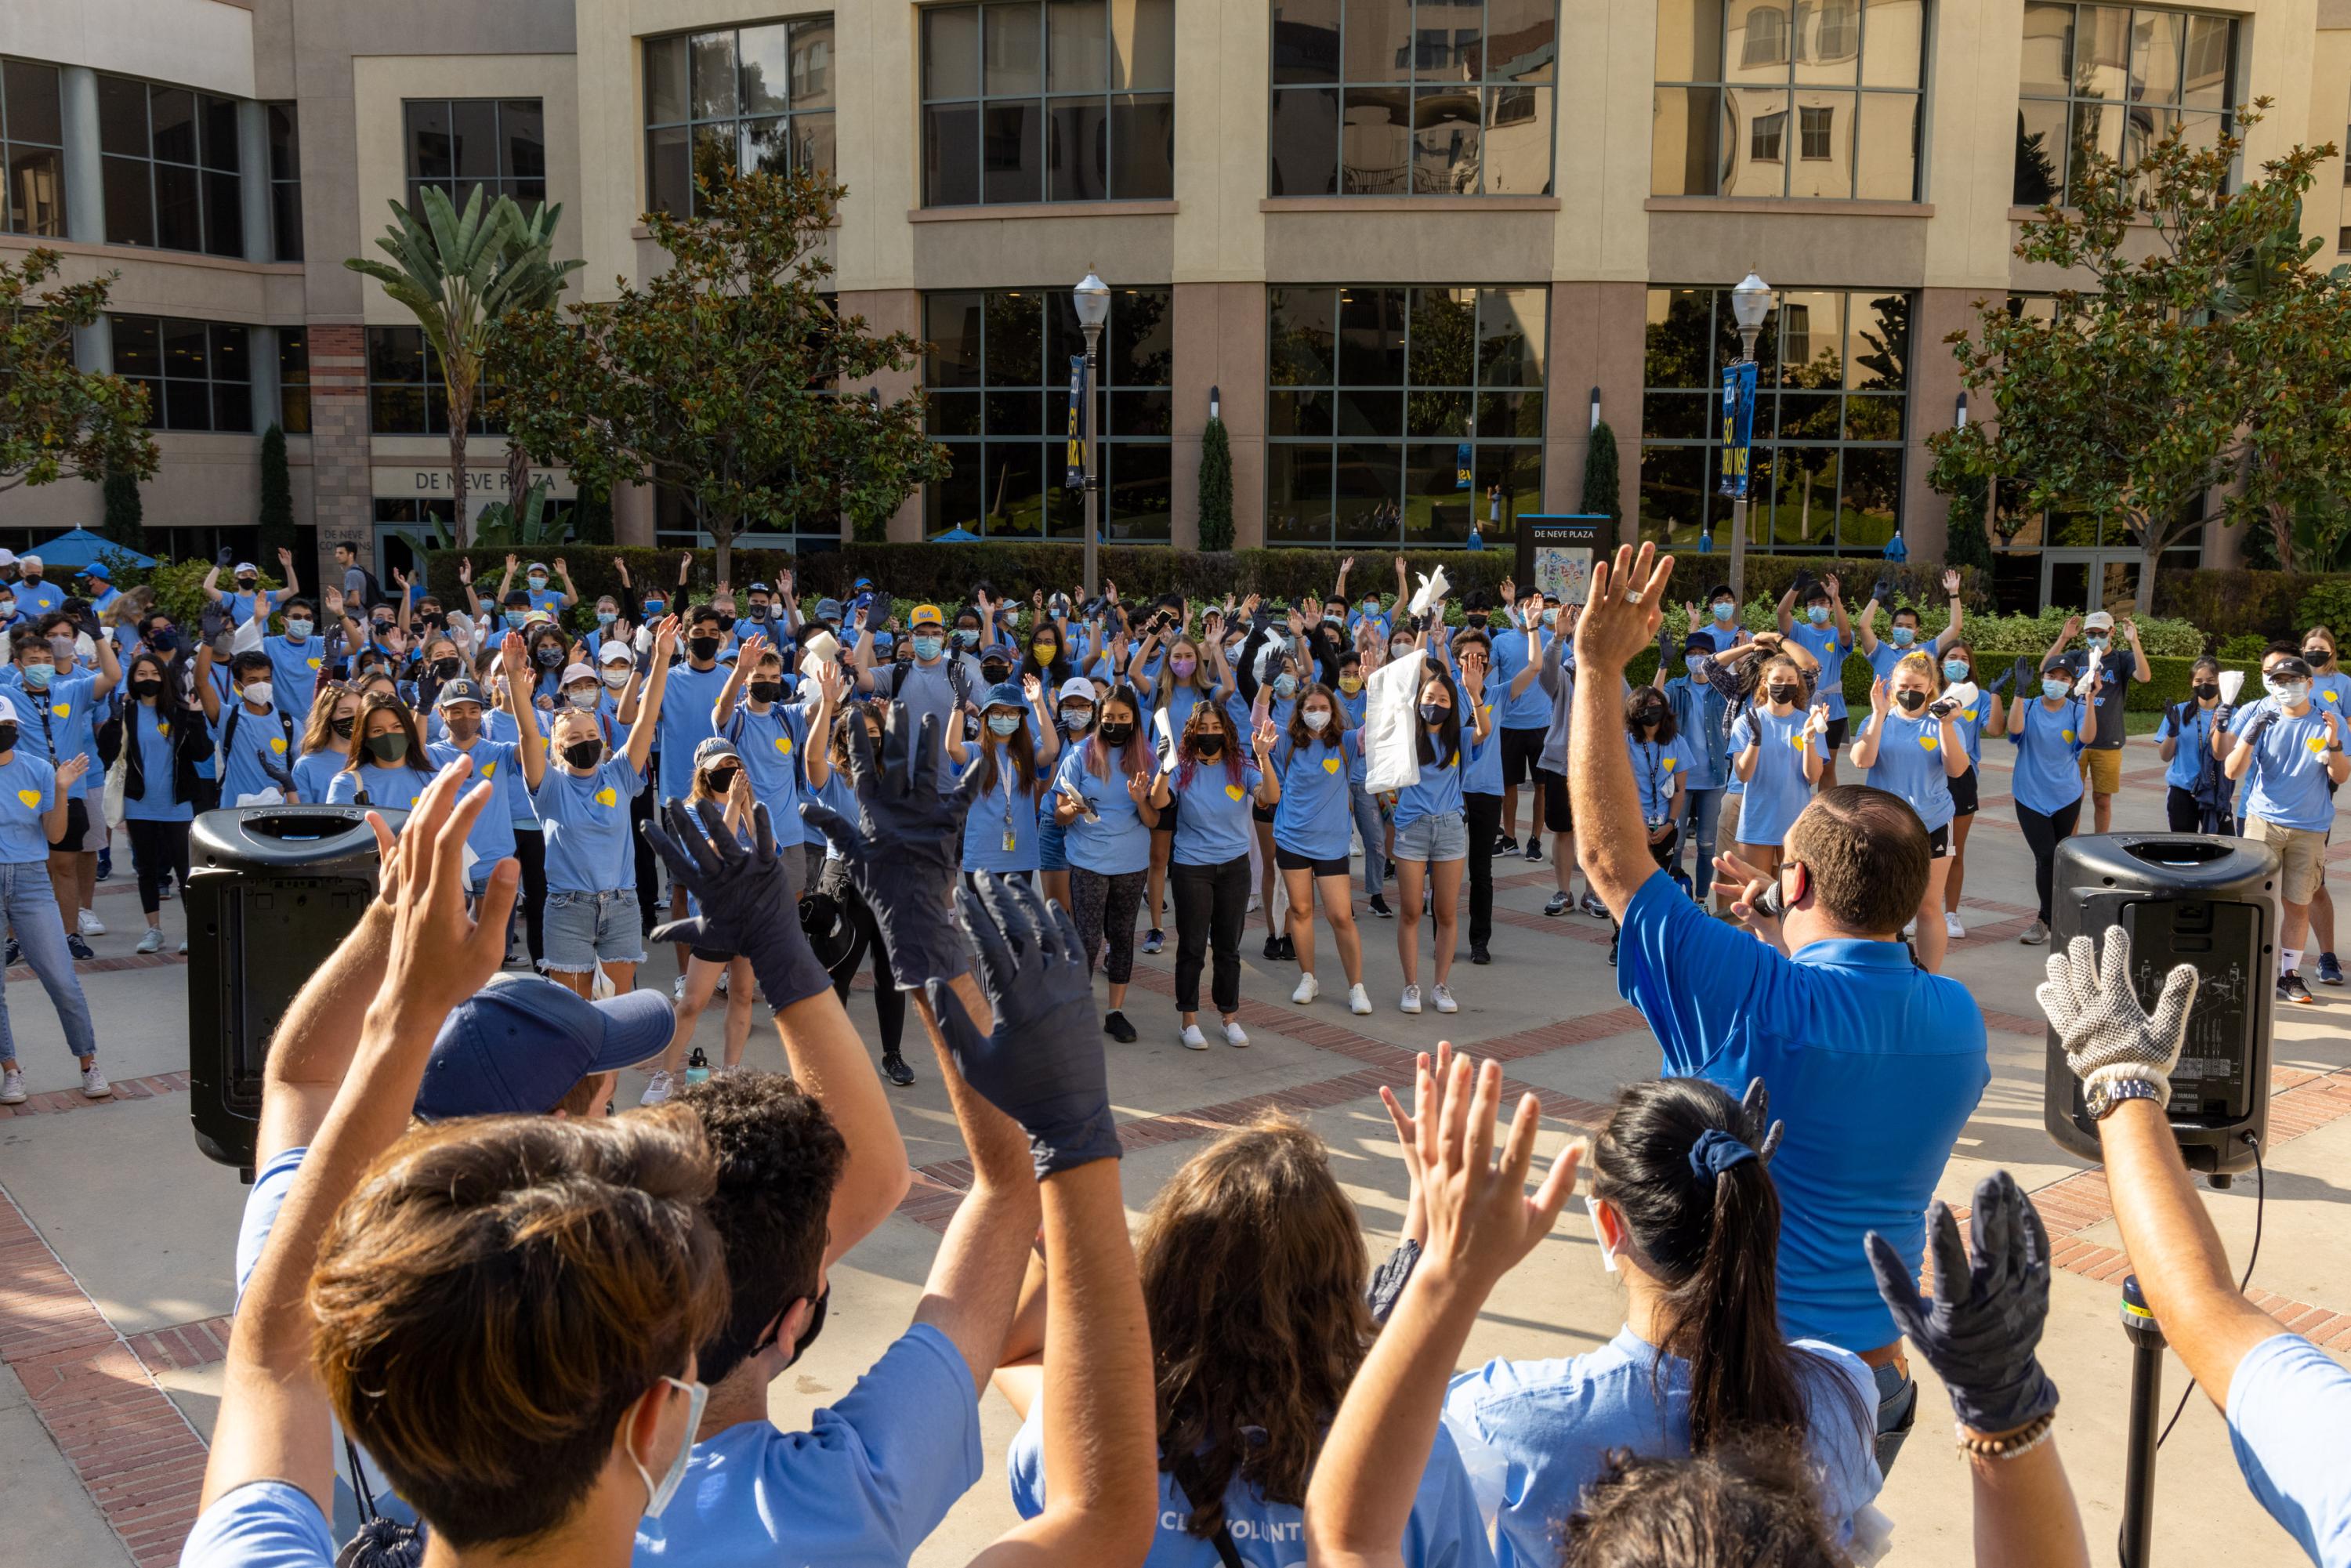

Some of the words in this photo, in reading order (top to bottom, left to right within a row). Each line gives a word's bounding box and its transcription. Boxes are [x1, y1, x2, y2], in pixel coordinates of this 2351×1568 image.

[1725, 386, 1735, 404] UCLA
[1723, 417, 1733, 445] GO
[416, 473, 439, 490] DE
[500, 473, 556, 491] PZA
[324, 530, 336, 539] DE
[339, 530, 364, 540] NEVE
[319, 541, 371, 551] CONS
[457, 683, 469, 694] B
